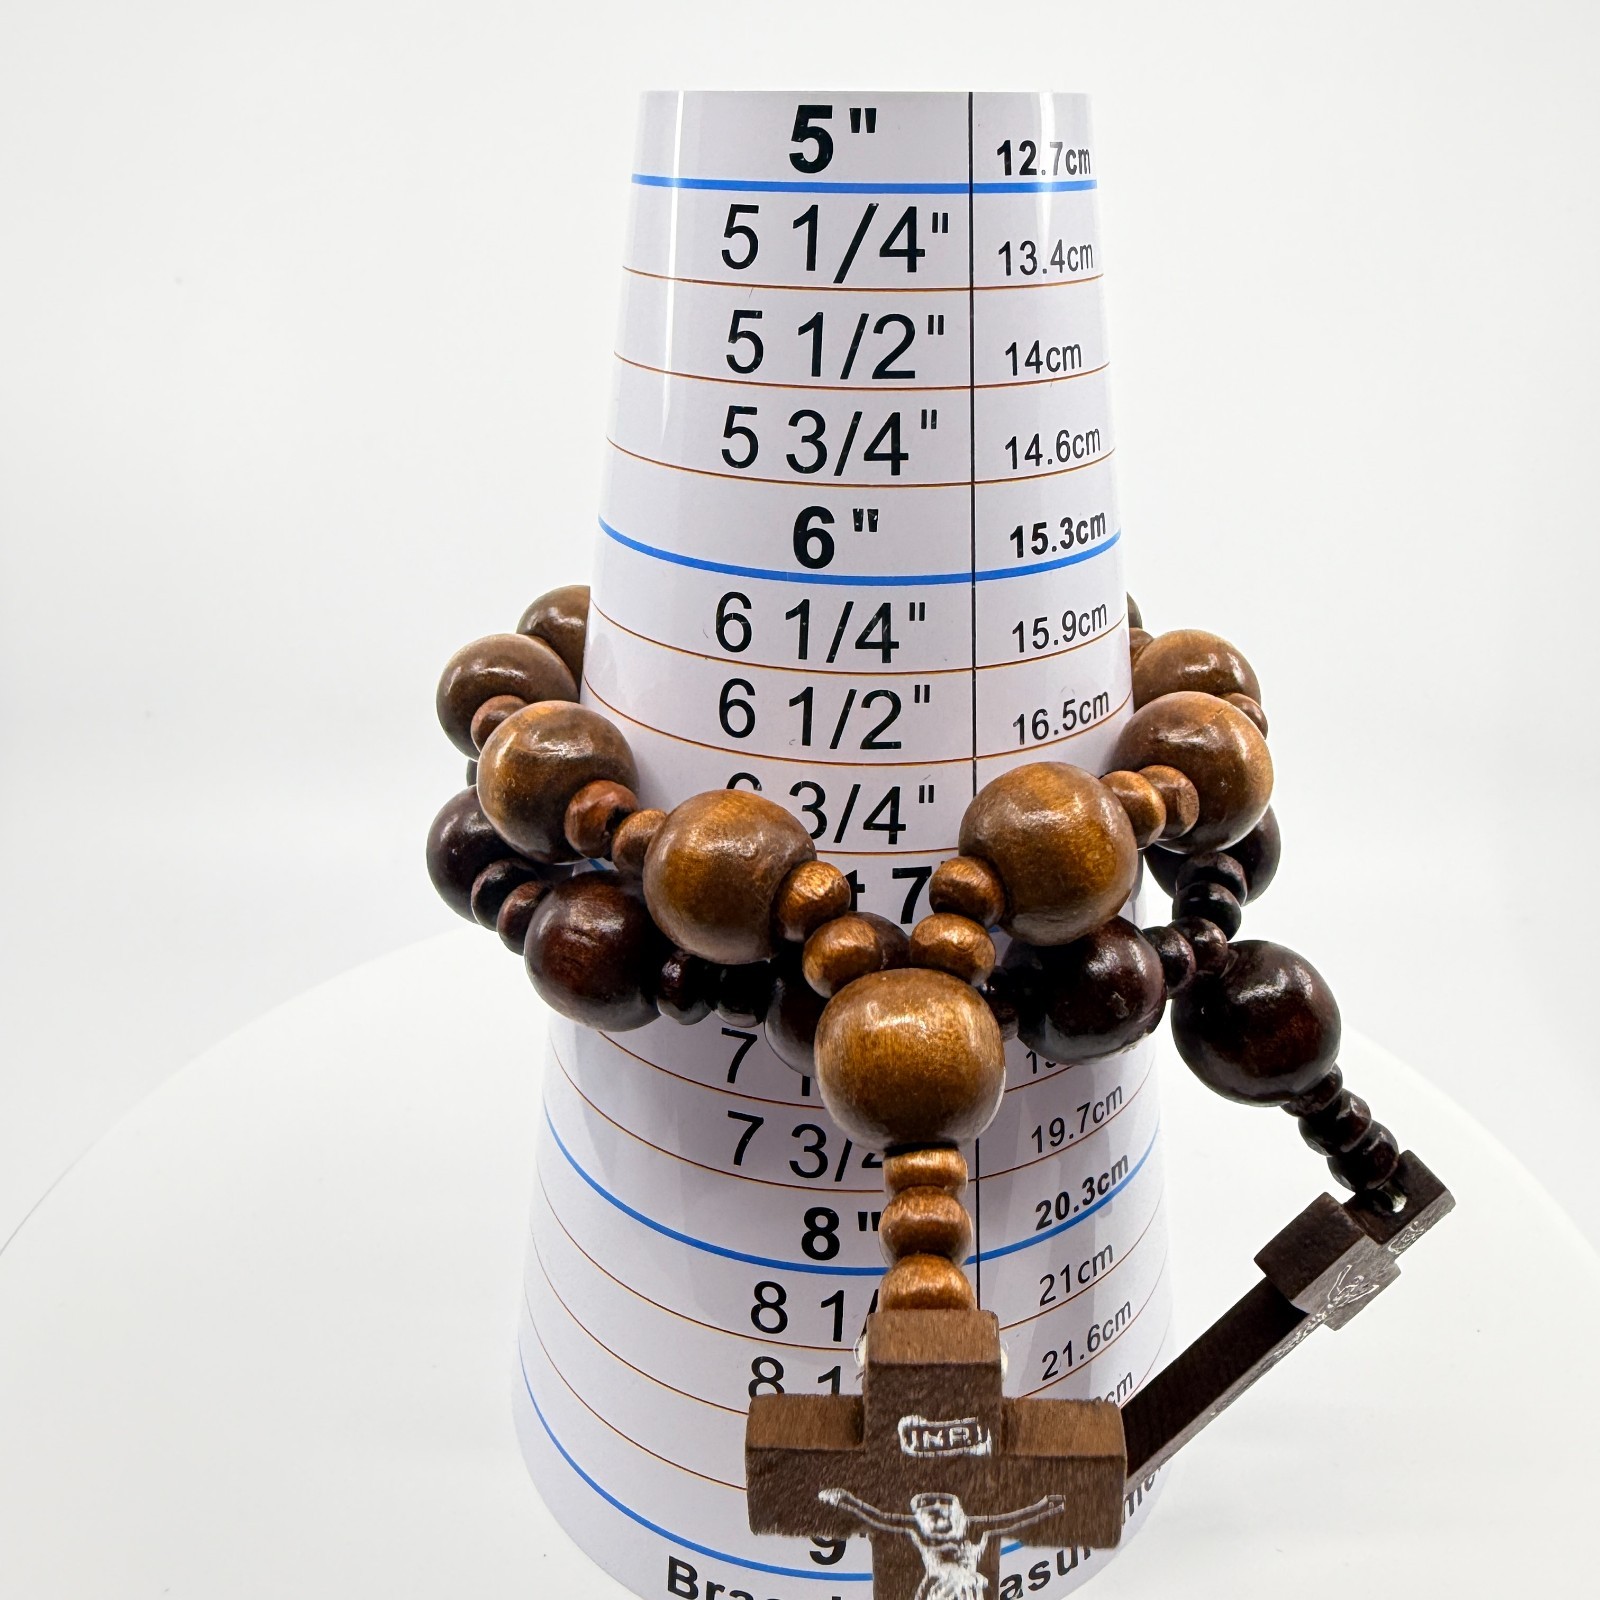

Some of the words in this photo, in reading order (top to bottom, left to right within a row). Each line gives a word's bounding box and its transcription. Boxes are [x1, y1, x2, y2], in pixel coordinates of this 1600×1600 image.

[789, 105, 877, 174] 5"
[997, 139, 1091, 176] 12.7cm
[721, 203, 760, 270] 5
[792, 203, 949, 284] 1/4"
[998, 240, 1094, 277] 13.4cm
[726, 310, 765, 374] 5
[798, 311, 945, 381] 1/2"
[1004, 340, 1082, 377] 14cm
[721, 405, 759, 469] 5
[786, 408, 938, 477] 3/4"
[1004, 426, 1101, 470] 14.6cm
[793, 506, 879, 569] 6"
[1009, 511, 1106, 558] 15.3cm
[715, 591, 753, 653] 6
[785, 599, 926, 663] 1/4"
[1011, 602, 1108, 653] 15.9cm
[718, 678, 756, 738] 6
[788, 684, 931, 750] 1/2"
[1013, 690, 1110, 745] 16.5cm
[789, 780, 935, 845] 3/4"
[892, 861, 944, 924] 7
[721, 1027, 758, 1083] 7
[727, 1110, 764, 1166] 7
[1030, 1084, 1123, 1154] 19.7cm
[1035, 1153, 1129, 1231] 20.3cm
[1039, 1243, 1114, 1306] 21cm
[750, 1280, 788, 1334] 8
[1041, 1300, 1132, 1381] 21.6cm
